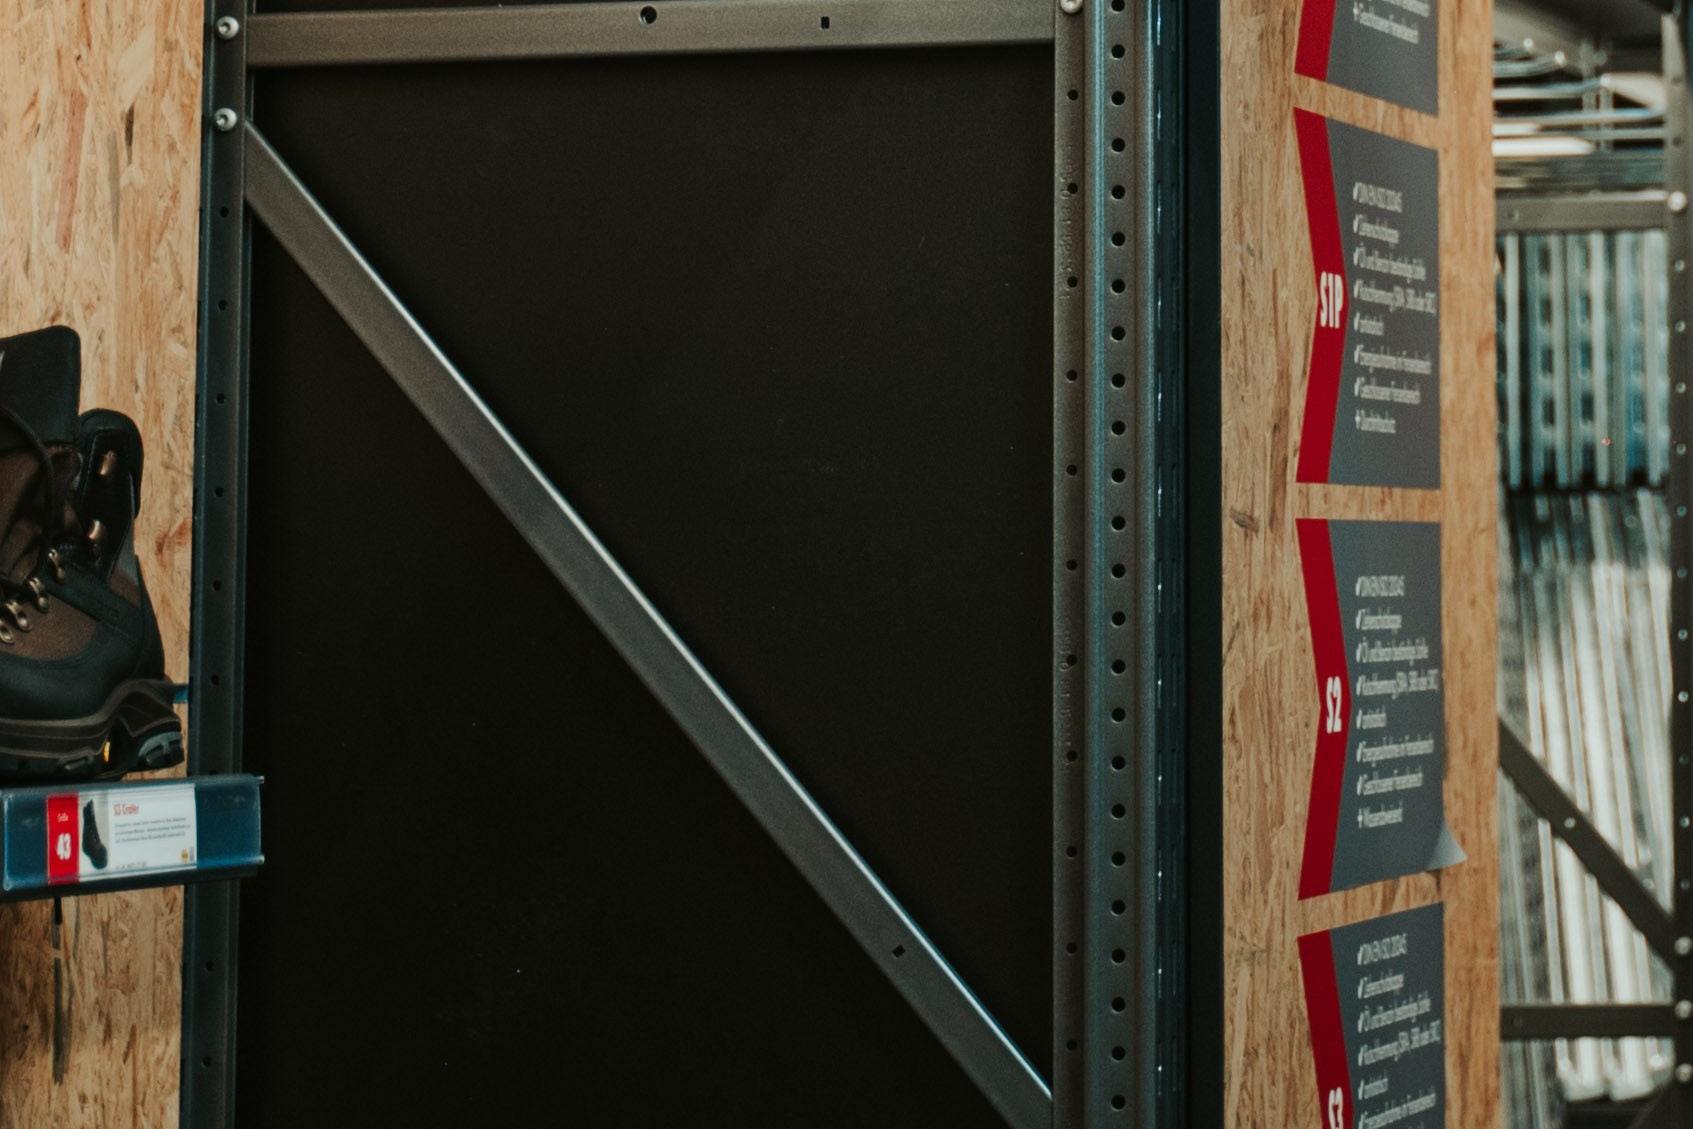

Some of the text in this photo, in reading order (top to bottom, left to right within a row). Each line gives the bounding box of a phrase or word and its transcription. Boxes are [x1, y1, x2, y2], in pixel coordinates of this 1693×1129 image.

[1320, 270, 1344, 329] S1P
[1326, 676, 1342, 734] S2
[56, 832, 71, 860] 43
